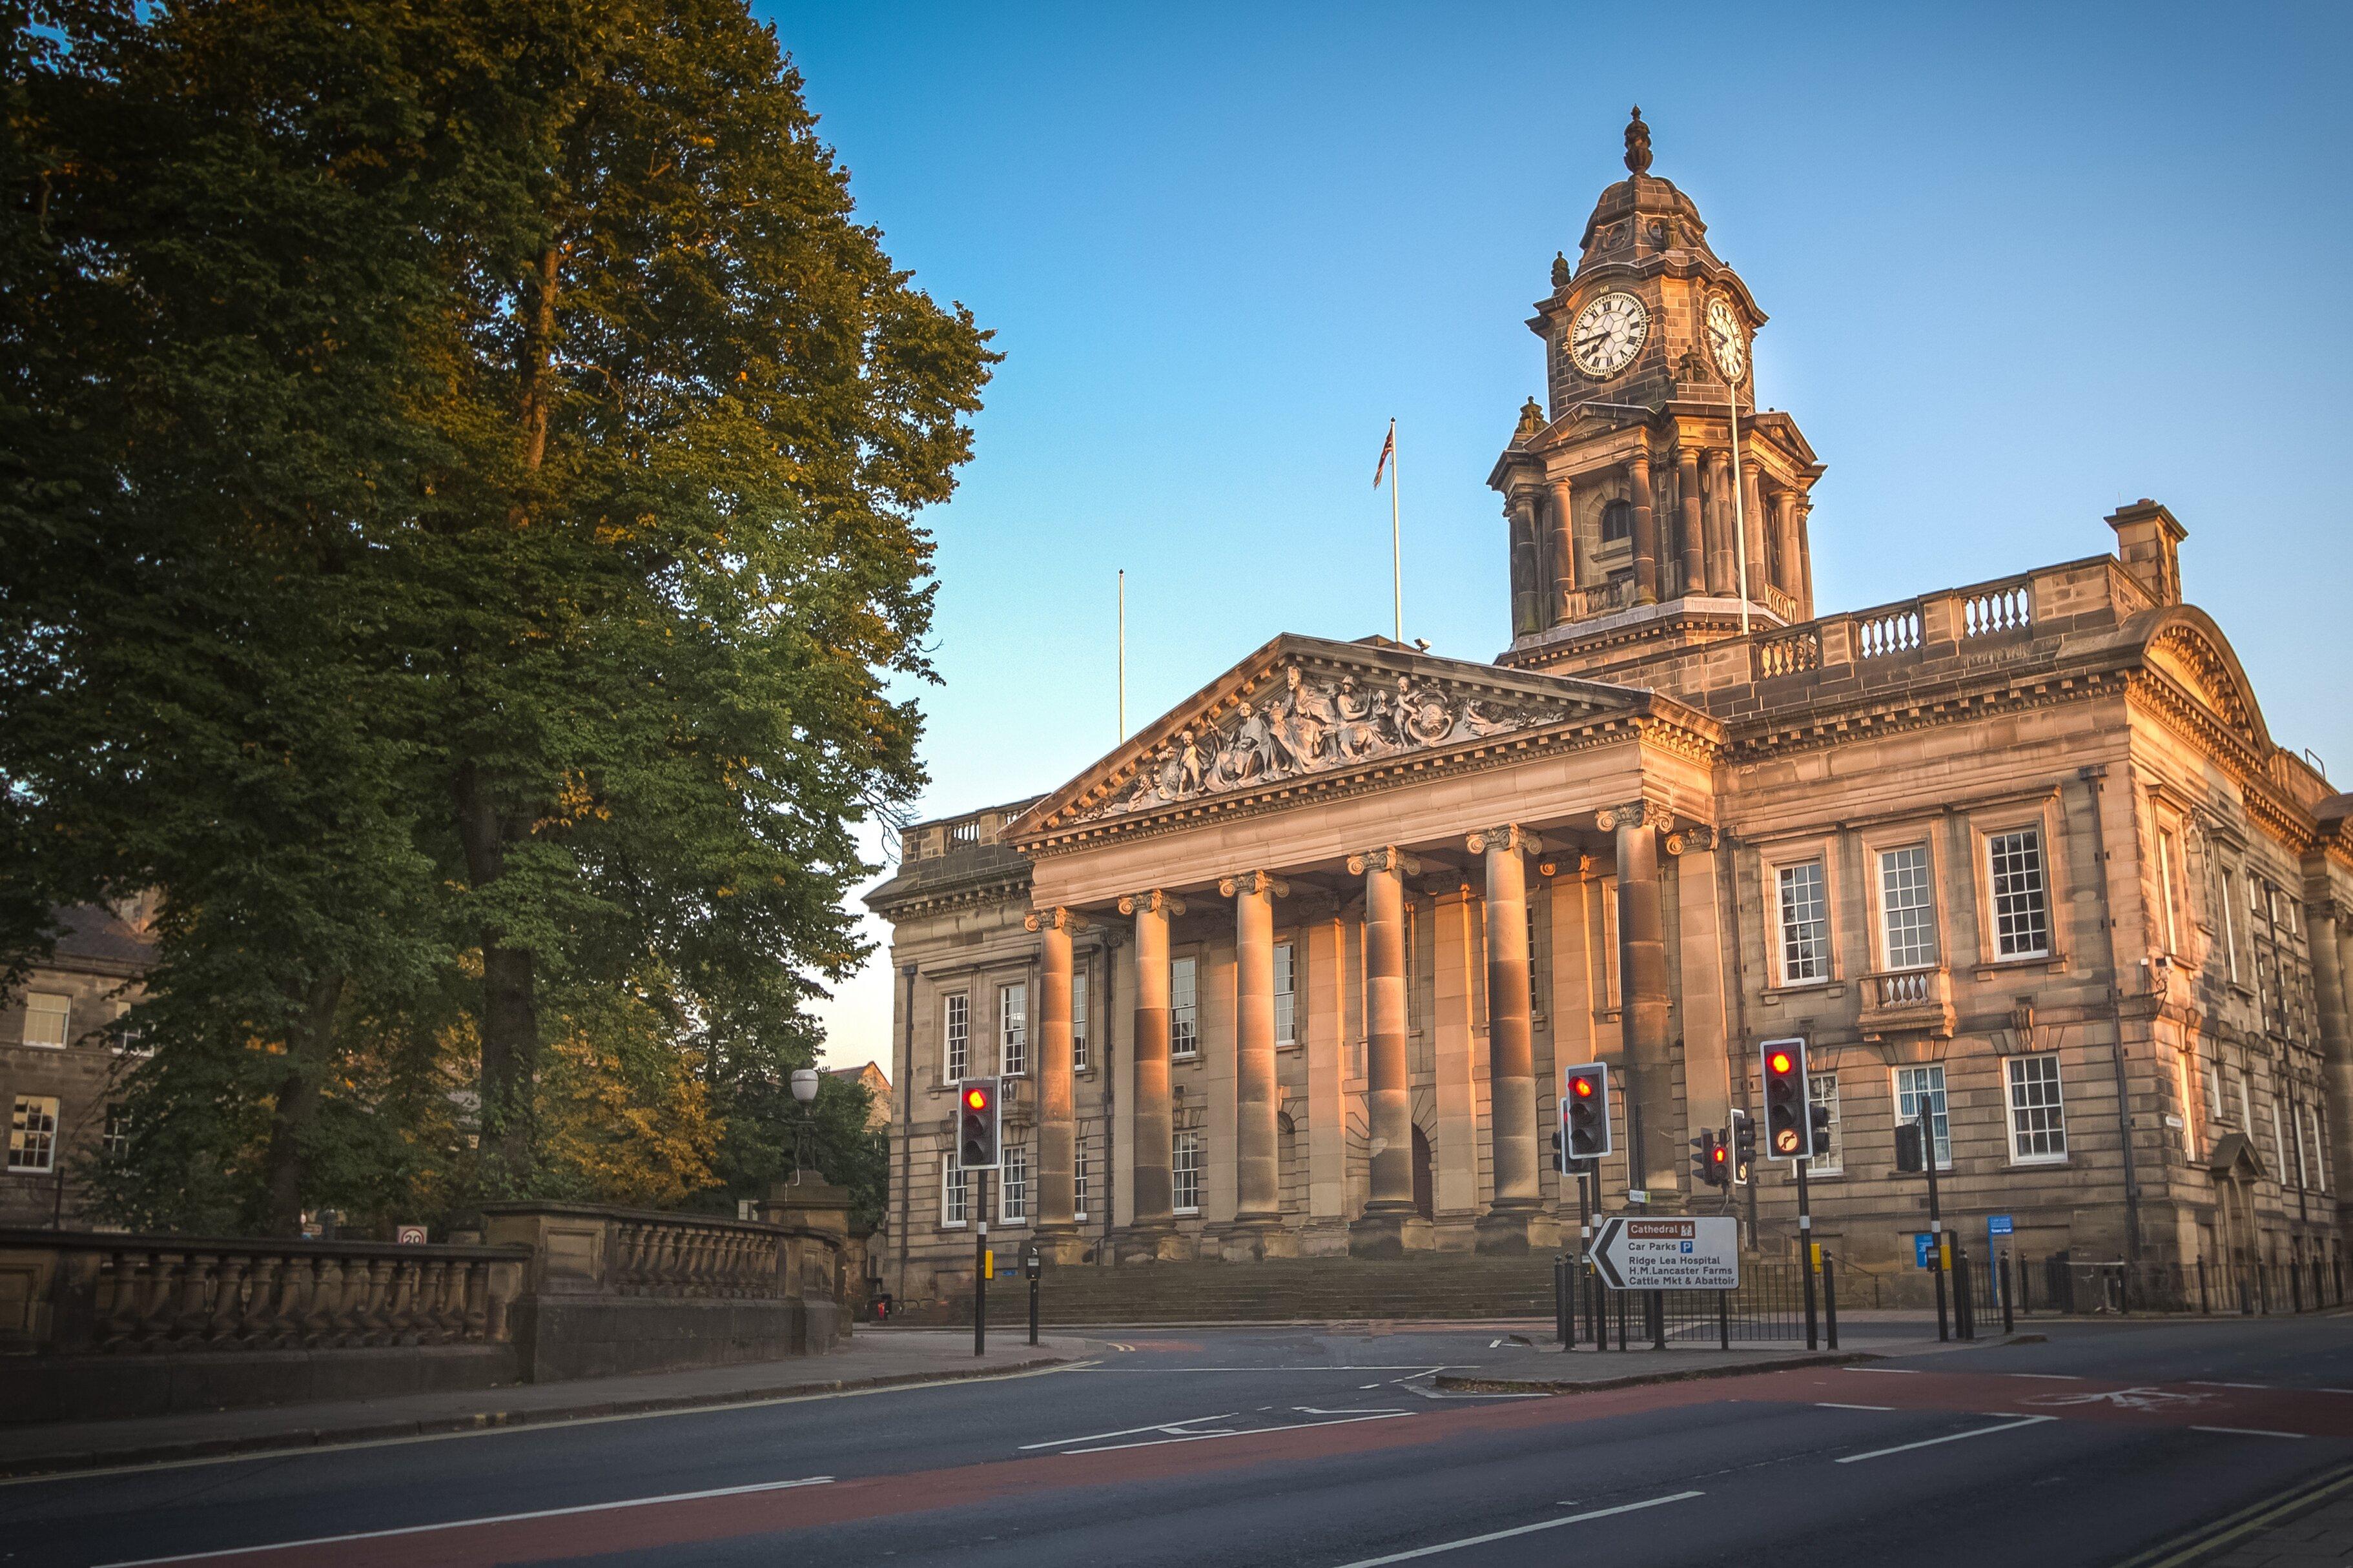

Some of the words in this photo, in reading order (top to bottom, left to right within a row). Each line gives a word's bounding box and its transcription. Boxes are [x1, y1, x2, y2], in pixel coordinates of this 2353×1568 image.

[1630, 1225, 1678, 1234] Cathedral
[405, 1235, 420, 1245] 20
[1628, 1242, 1645, 1251] Car
[1649, 1242, 1677, 1251] Parks
[1683, 1242, 1691, 1252] P
[1629, 1256, 1656, 1266] Ridge
[1659, 1256, 1676, 1265] Lea
[1680, 1256, 1721, 1266] Hospital
[1703, 1266, 1732, 1275] Farms
[1629, 1276, 1659, 1285] Cattle
[1663, 1276, 1682, 1285] Mkt
[1685, 1276, 1692, 1285] &
[1694, 1276, 1735, 1285] Abattoir
